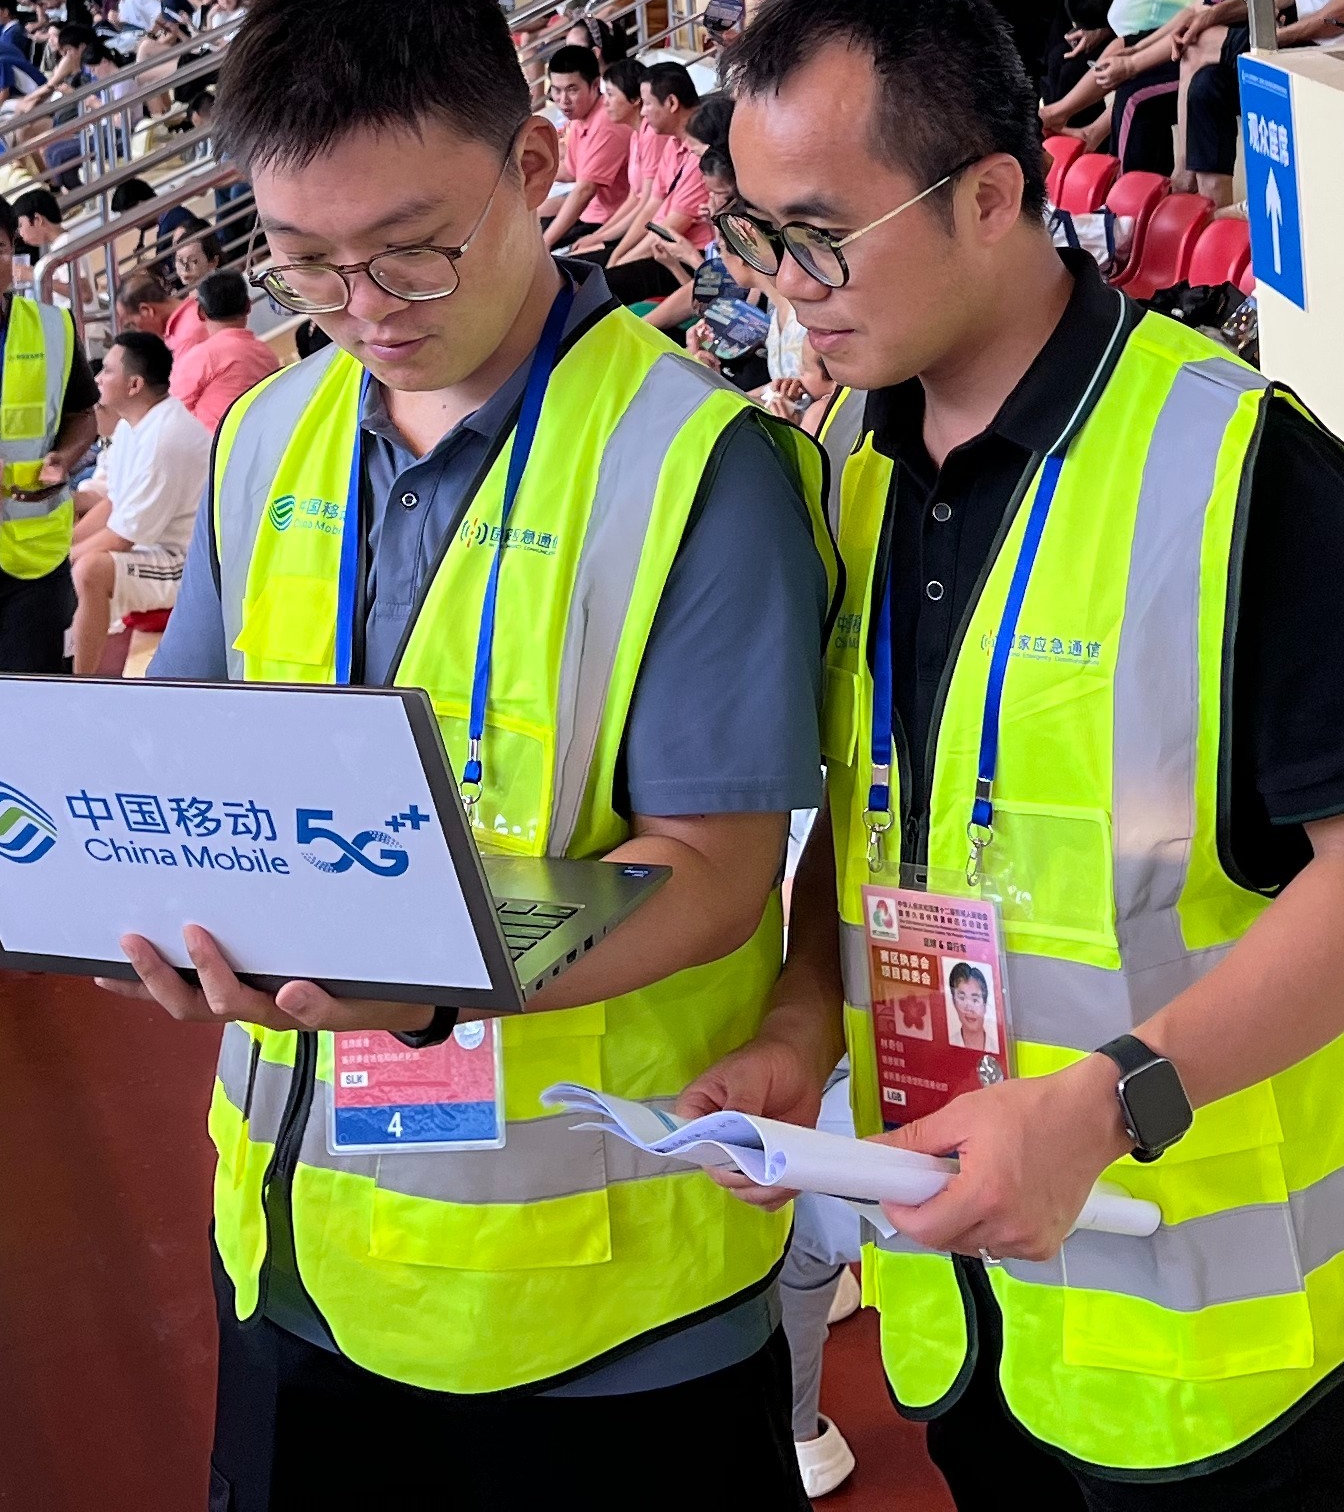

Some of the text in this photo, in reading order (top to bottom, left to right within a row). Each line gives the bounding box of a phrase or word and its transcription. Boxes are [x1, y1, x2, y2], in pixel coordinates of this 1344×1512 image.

[66, 788, 278, 842] 中国移动
[84, 837, 291, 875] China Mobile
[387, 1111, 403, 1138] 4
